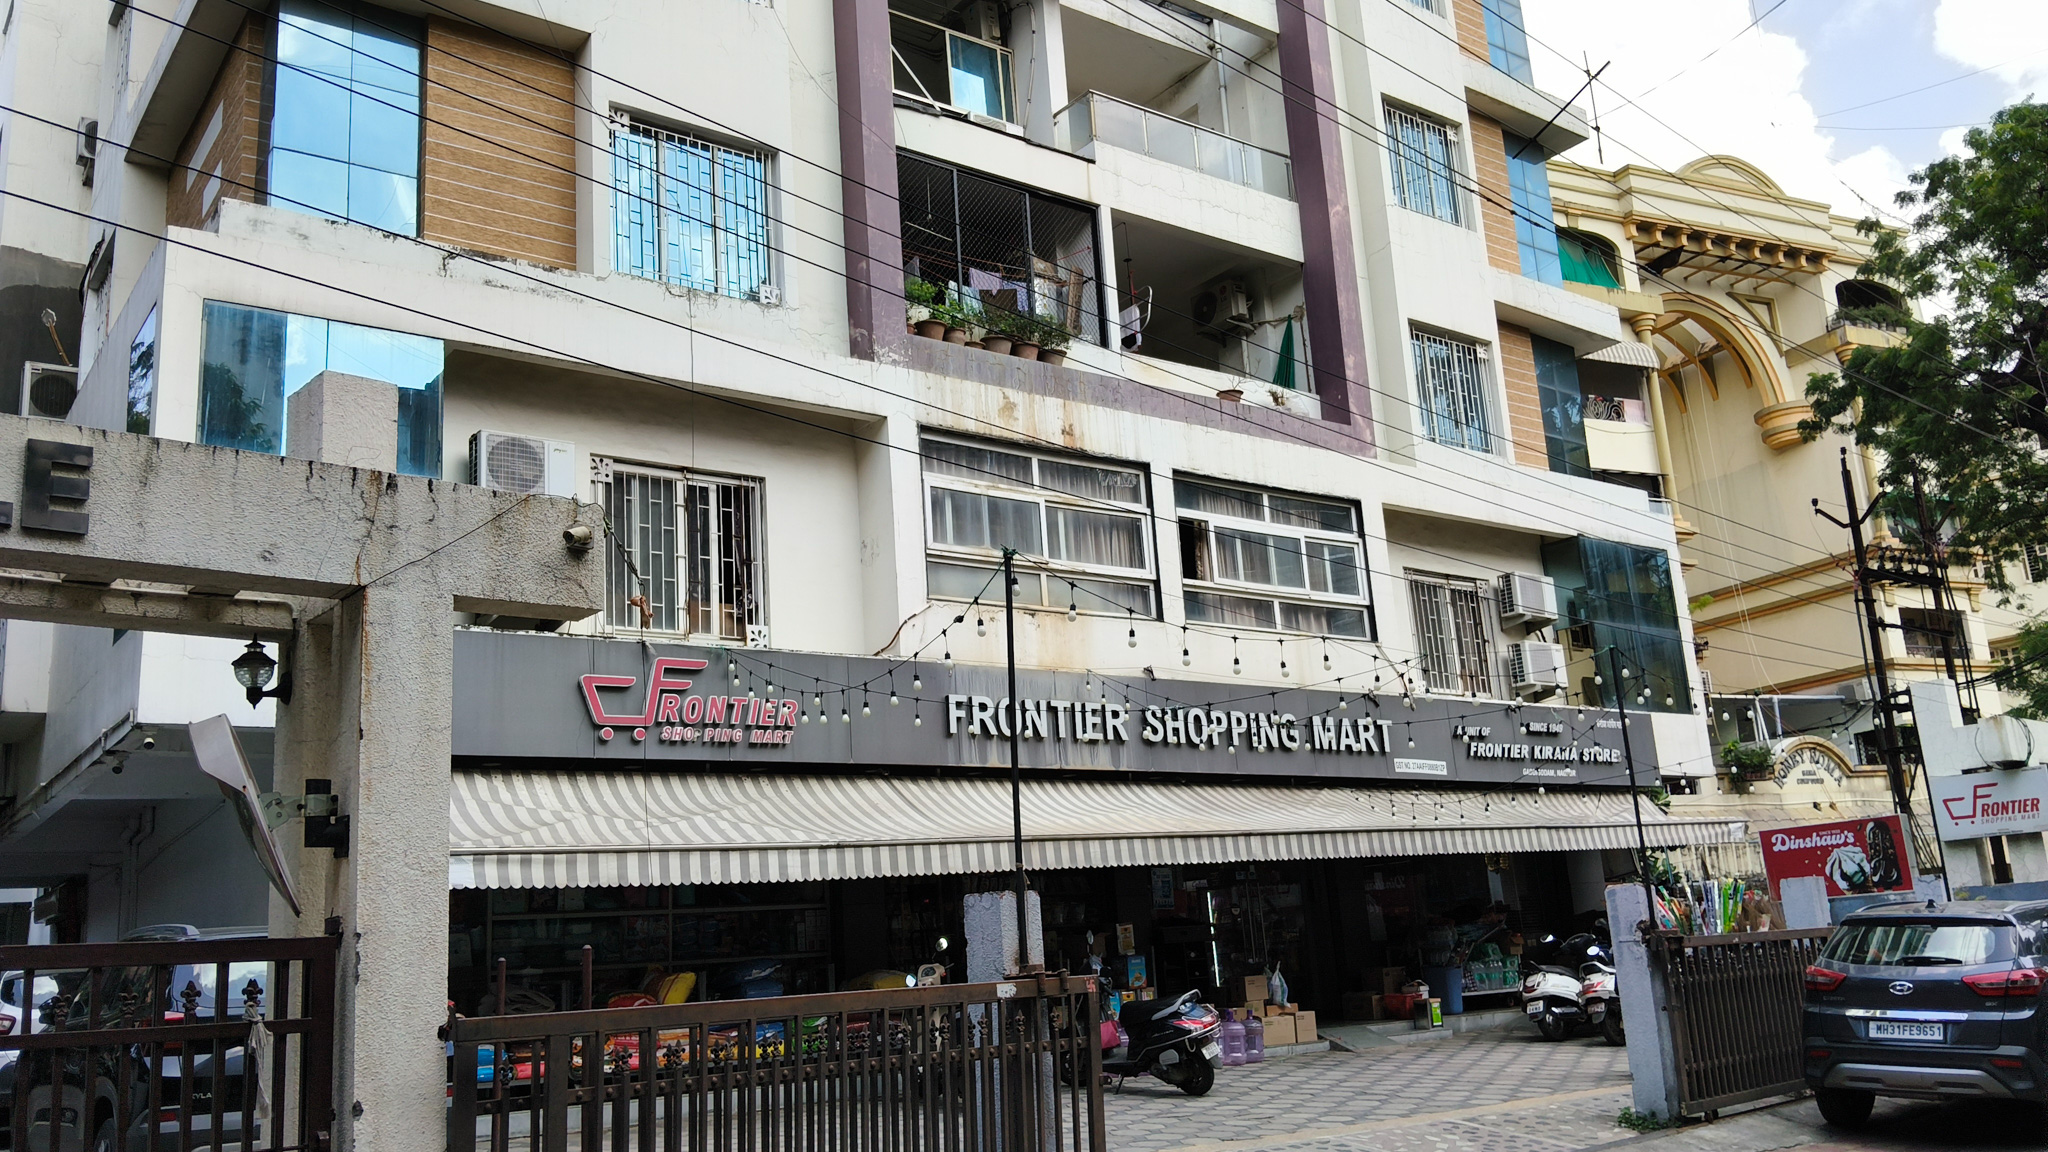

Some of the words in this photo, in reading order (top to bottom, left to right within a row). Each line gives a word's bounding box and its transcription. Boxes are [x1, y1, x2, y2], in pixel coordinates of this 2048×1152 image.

[645, 657, 798, 727] FRONTIER
[946, 695, 1129, 740] FRONTIER
[1145, 705, 1300, 749] SHOPPING
[1312, 715, 1392, 752] MART
[1481, 727, 1491, 736] OF
[1529, 722, 1547, 732] SINCE
[750, 730, 793, 744] MART
[1470, 742, 1529, 758] FRONTIER
[1534, 745, 1577, 760] KIRANA
[1972, 782, 2040, 818] FRONTIER
[1981, 815, 2017, 824] SHOPPING
[1771, 830, 1855, 852] Dinshaw's
[1875, 1023, 1942, 1036] MH31FE9651
